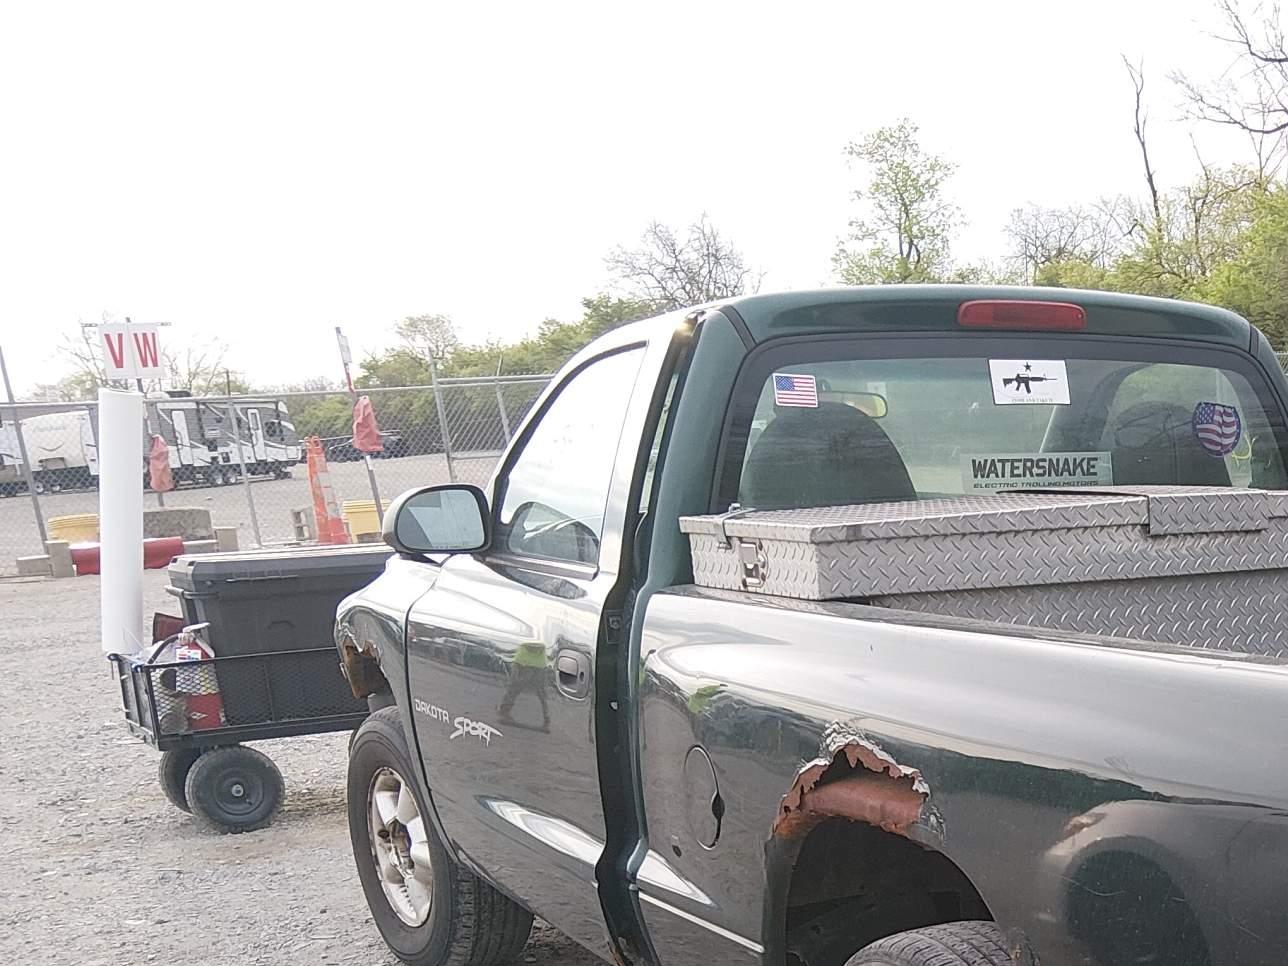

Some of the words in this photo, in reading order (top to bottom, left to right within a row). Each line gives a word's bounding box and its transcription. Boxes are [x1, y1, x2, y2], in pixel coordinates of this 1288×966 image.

[971, 456, 1098, 479] WATERSNAKE
[1021, 480, 1062, 489] TROLLING
[414, 698, 450, 724] DAKOTA
[449, 716, 504, 748] SPORT
